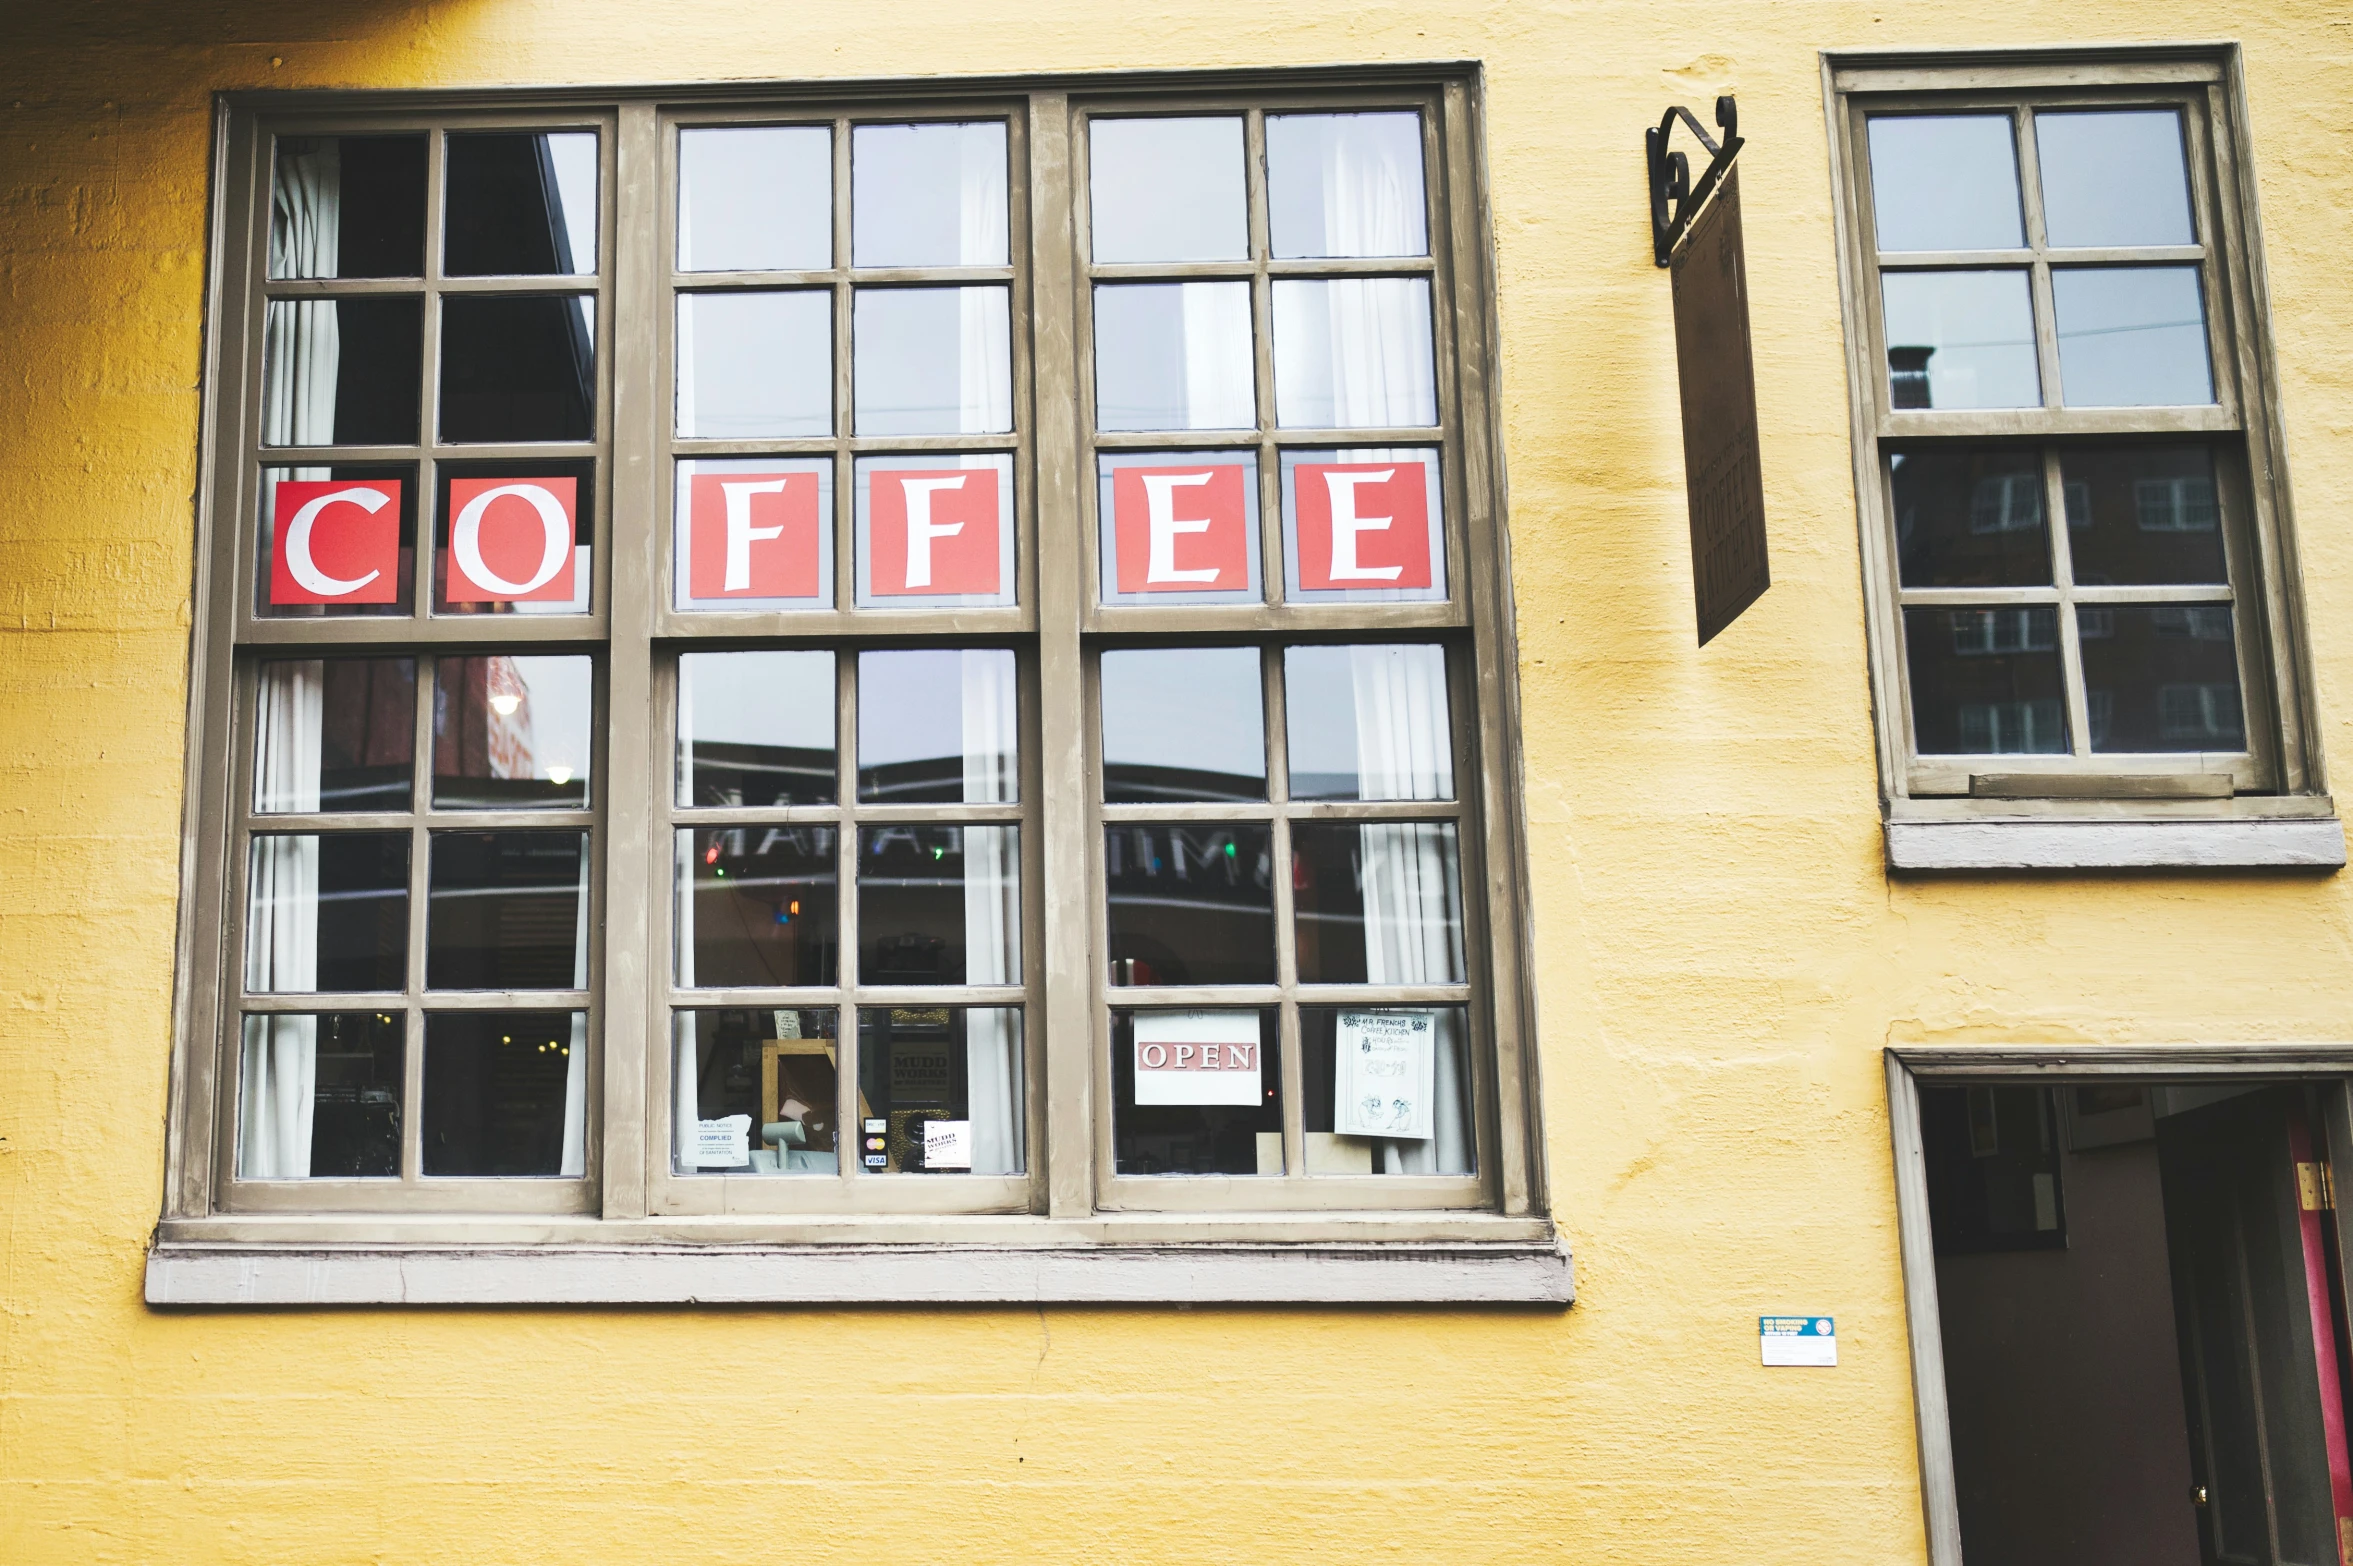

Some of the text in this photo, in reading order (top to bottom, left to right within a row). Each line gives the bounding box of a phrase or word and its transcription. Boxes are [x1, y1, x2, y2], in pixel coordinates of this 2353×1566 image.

[1704, 453, 1749, 542] COFFEE
[285, 468, 1403, 596] COFFEE
[1704, 510, 1755, 600] KITCHEN
[894, 1056, 947, 1068] MUDD
[1142, 1044, 1252, 1069] OPEN
[894, 1068, 947, 1079] WORKS
[926, 1133, 956, 1144] MUDD
[927, 1138, 957, 1149] WORKS
